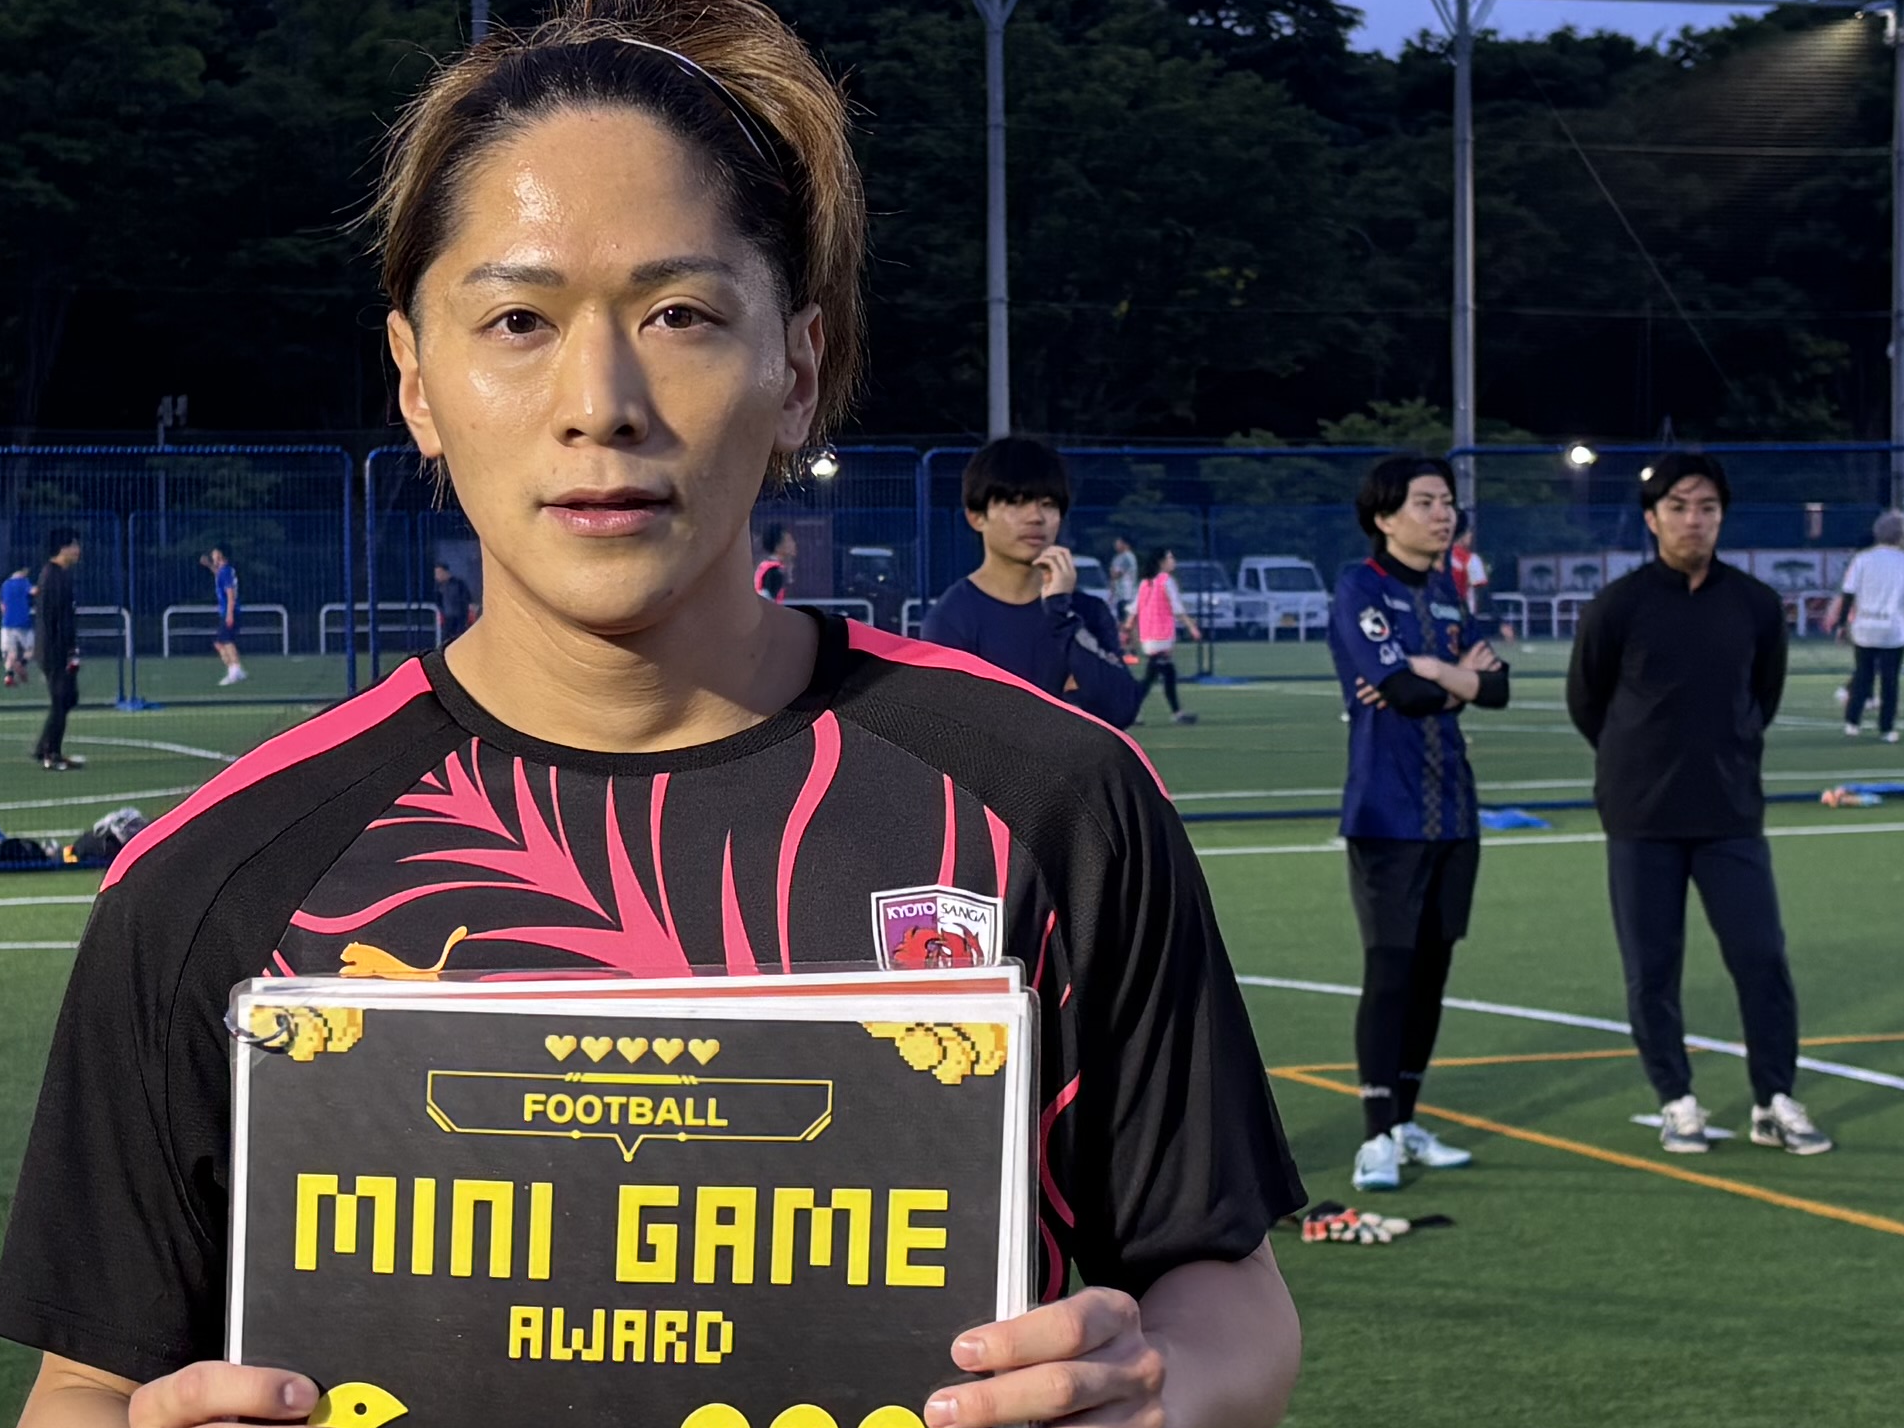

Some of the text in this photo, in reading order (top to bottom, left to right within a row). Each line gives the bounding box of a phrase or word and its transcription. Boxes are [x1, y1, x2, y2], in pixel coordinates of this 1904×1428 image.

[886, 901, 988, 925] KYOTO SANGA
[522, 1092, 729, 1127] FOOTBALL
[294, 1172, 949, 1287] MINI GAME
[508, 1305, 734, 1364] AWARD
